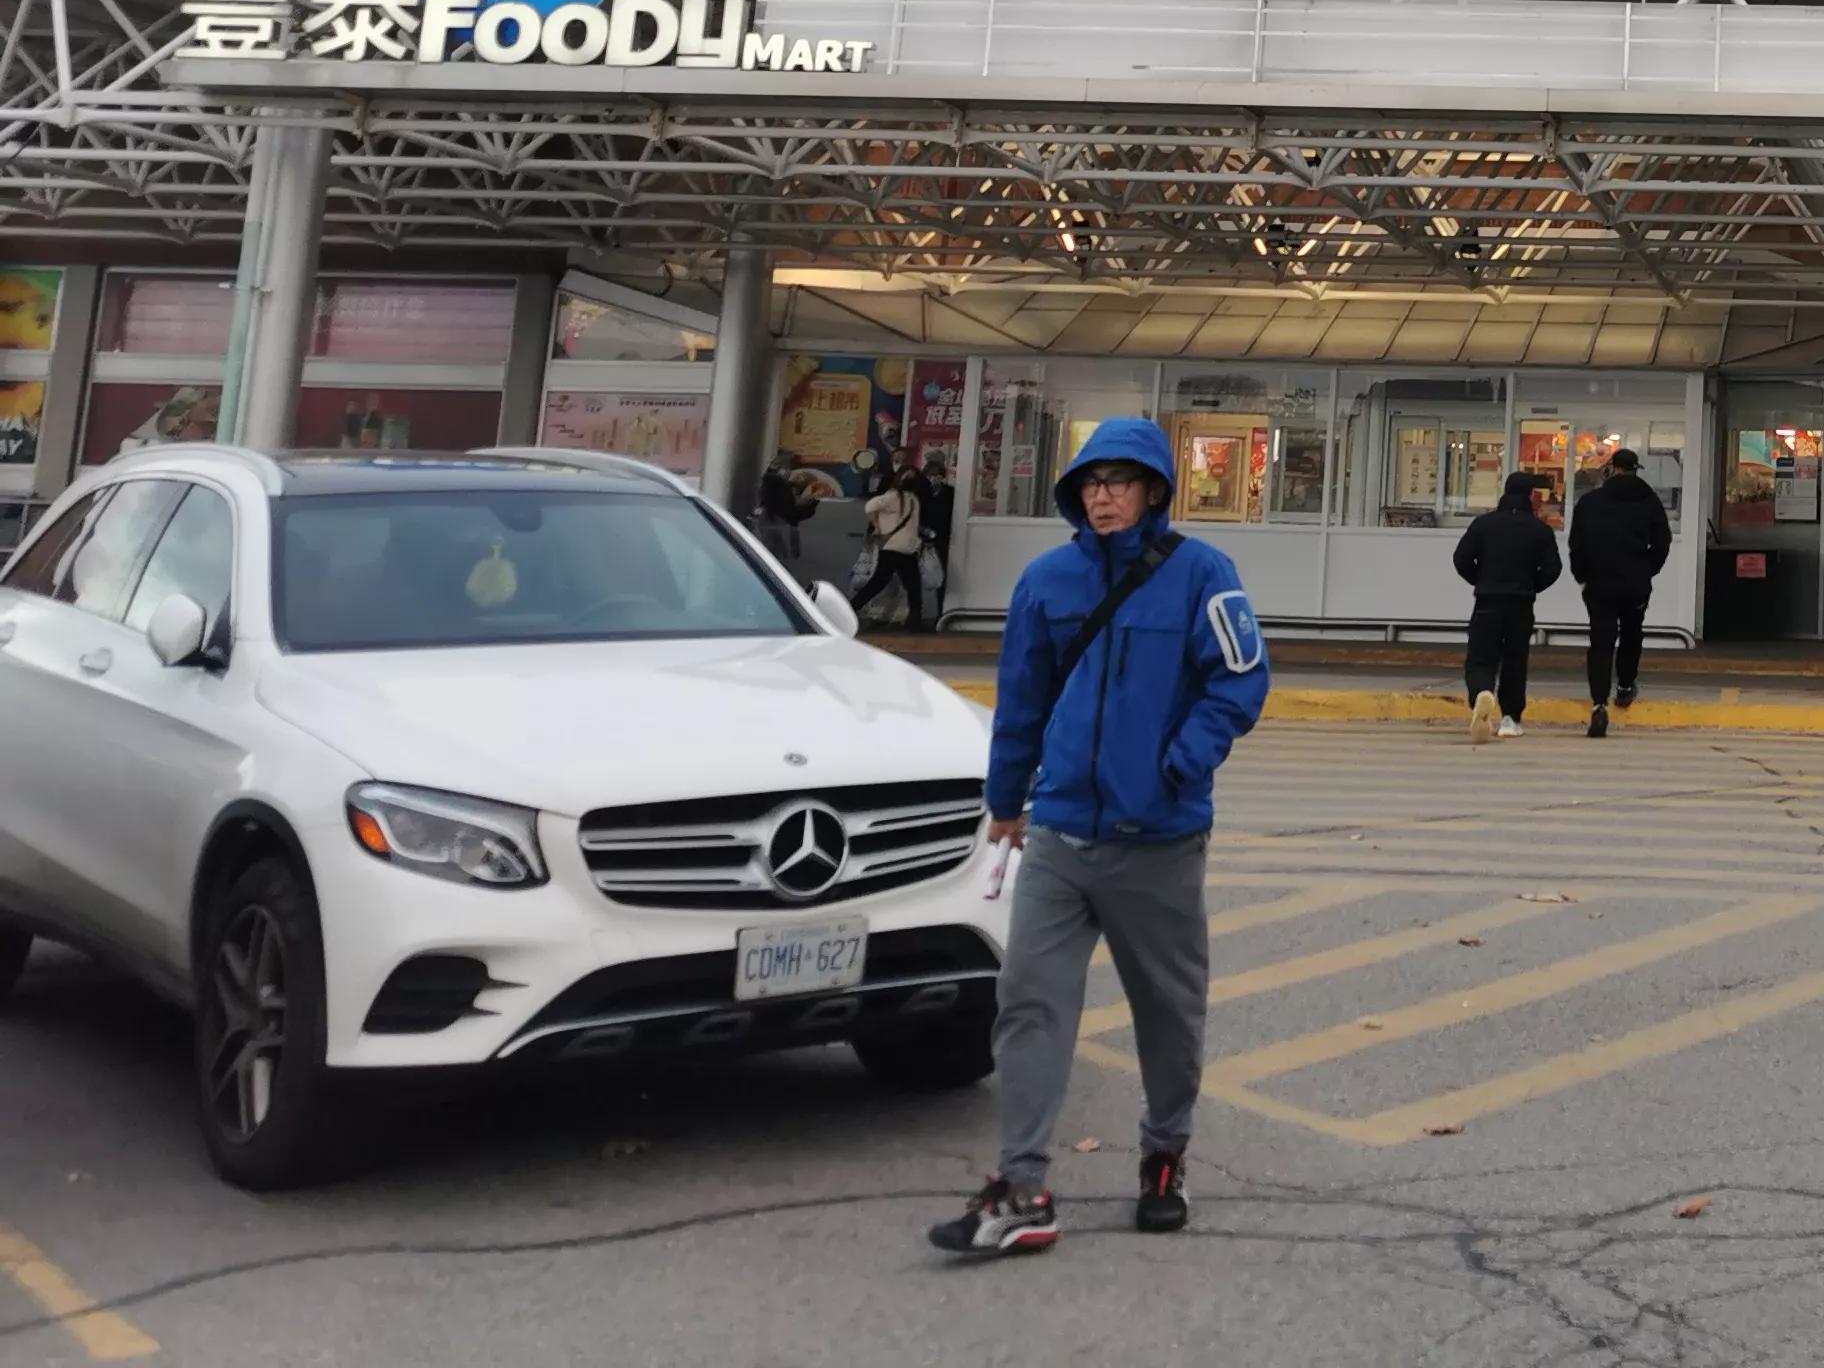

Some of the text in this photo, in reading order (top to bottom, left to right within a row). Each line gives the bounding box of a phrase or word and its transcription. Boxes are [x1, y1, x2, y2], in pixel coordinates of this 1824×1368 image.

[743, 34, 872, 73] MART
[744, 936, 861, 983] CDMH 627
